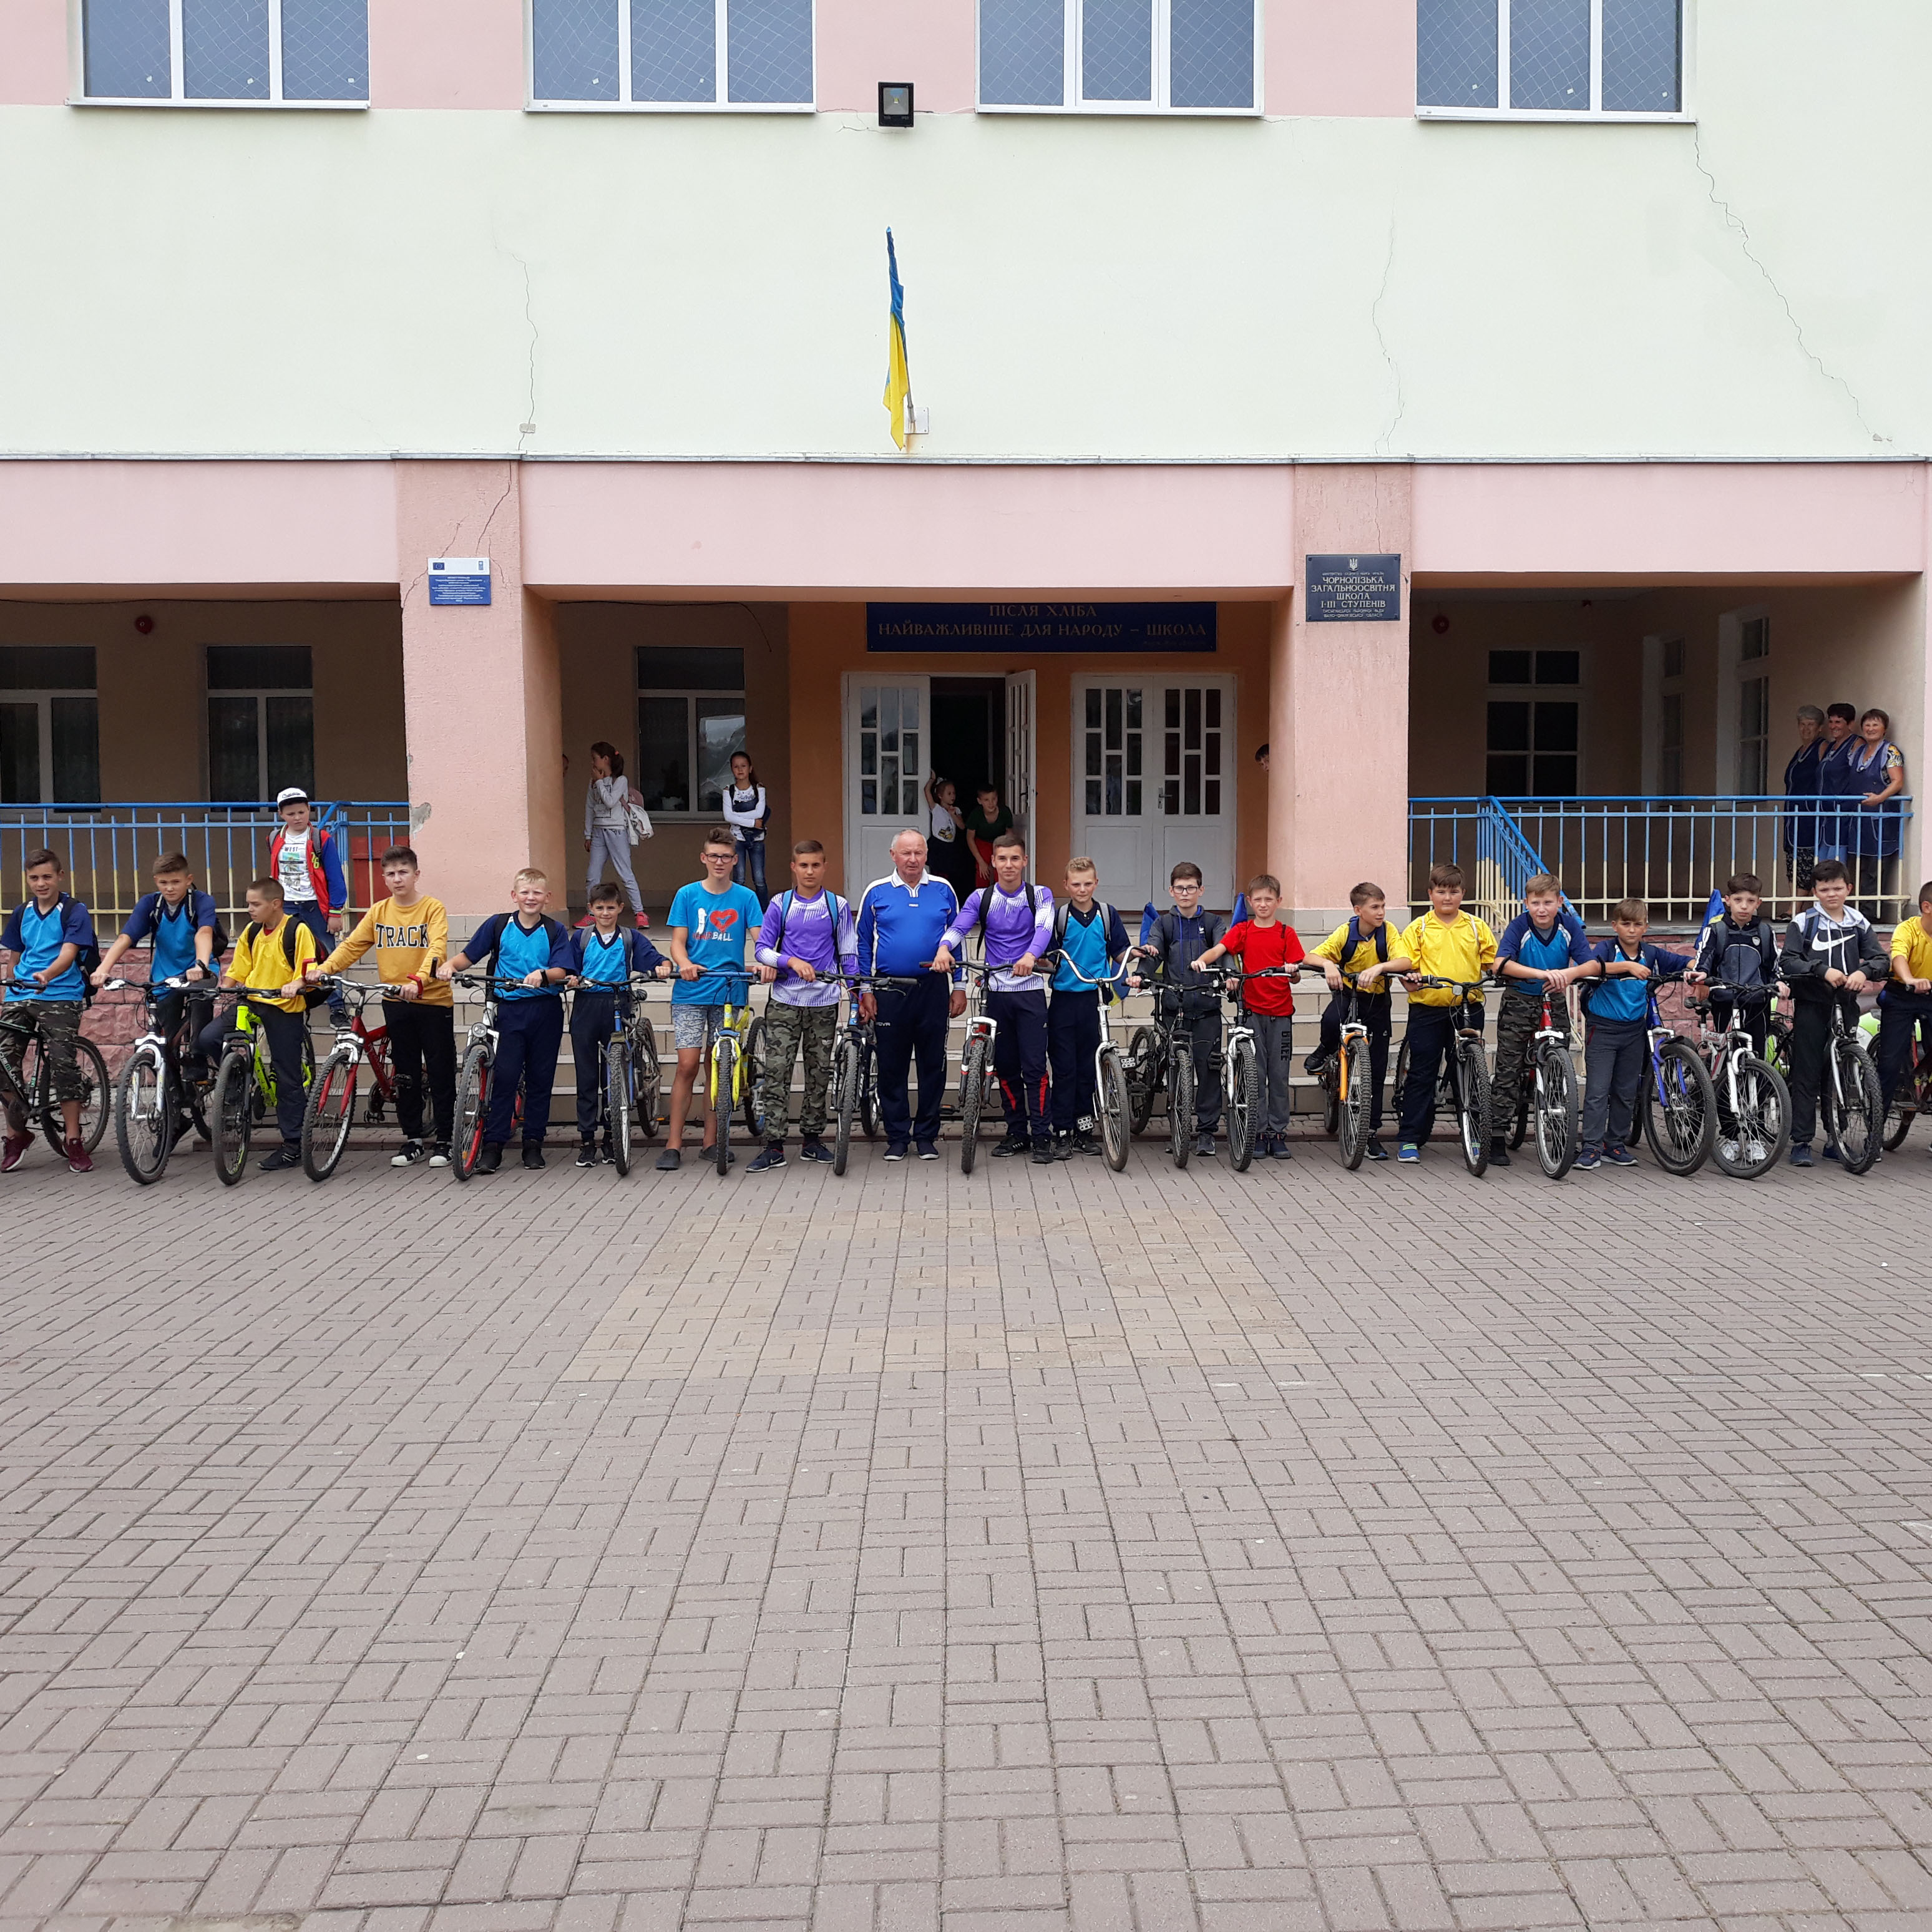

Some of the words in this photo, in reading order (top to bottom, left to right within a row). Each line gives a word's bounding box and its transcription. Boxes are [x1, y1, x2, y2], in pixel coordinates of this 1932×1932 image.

[1311, 584, 1395, 592] ЗАГАЛЬНООСВІТНЯ
[989, 604, 1038, 617] ПІСЛЯ
[1046, 604, 1097, 617] ХЛІБА
[1341, 600, 1386, 608] СТУПЕНІВ
[878, 619, 1014, 635] НАЙВАЖЛИВІШЕ
[1020, 623, 1051, 637] ДЛЯ
[1058, 623, 1123, 637] НАРОДУ
[1146, 623, 1206, 636] ШКОЛА
[374, 923, 429, 949] TRACK
